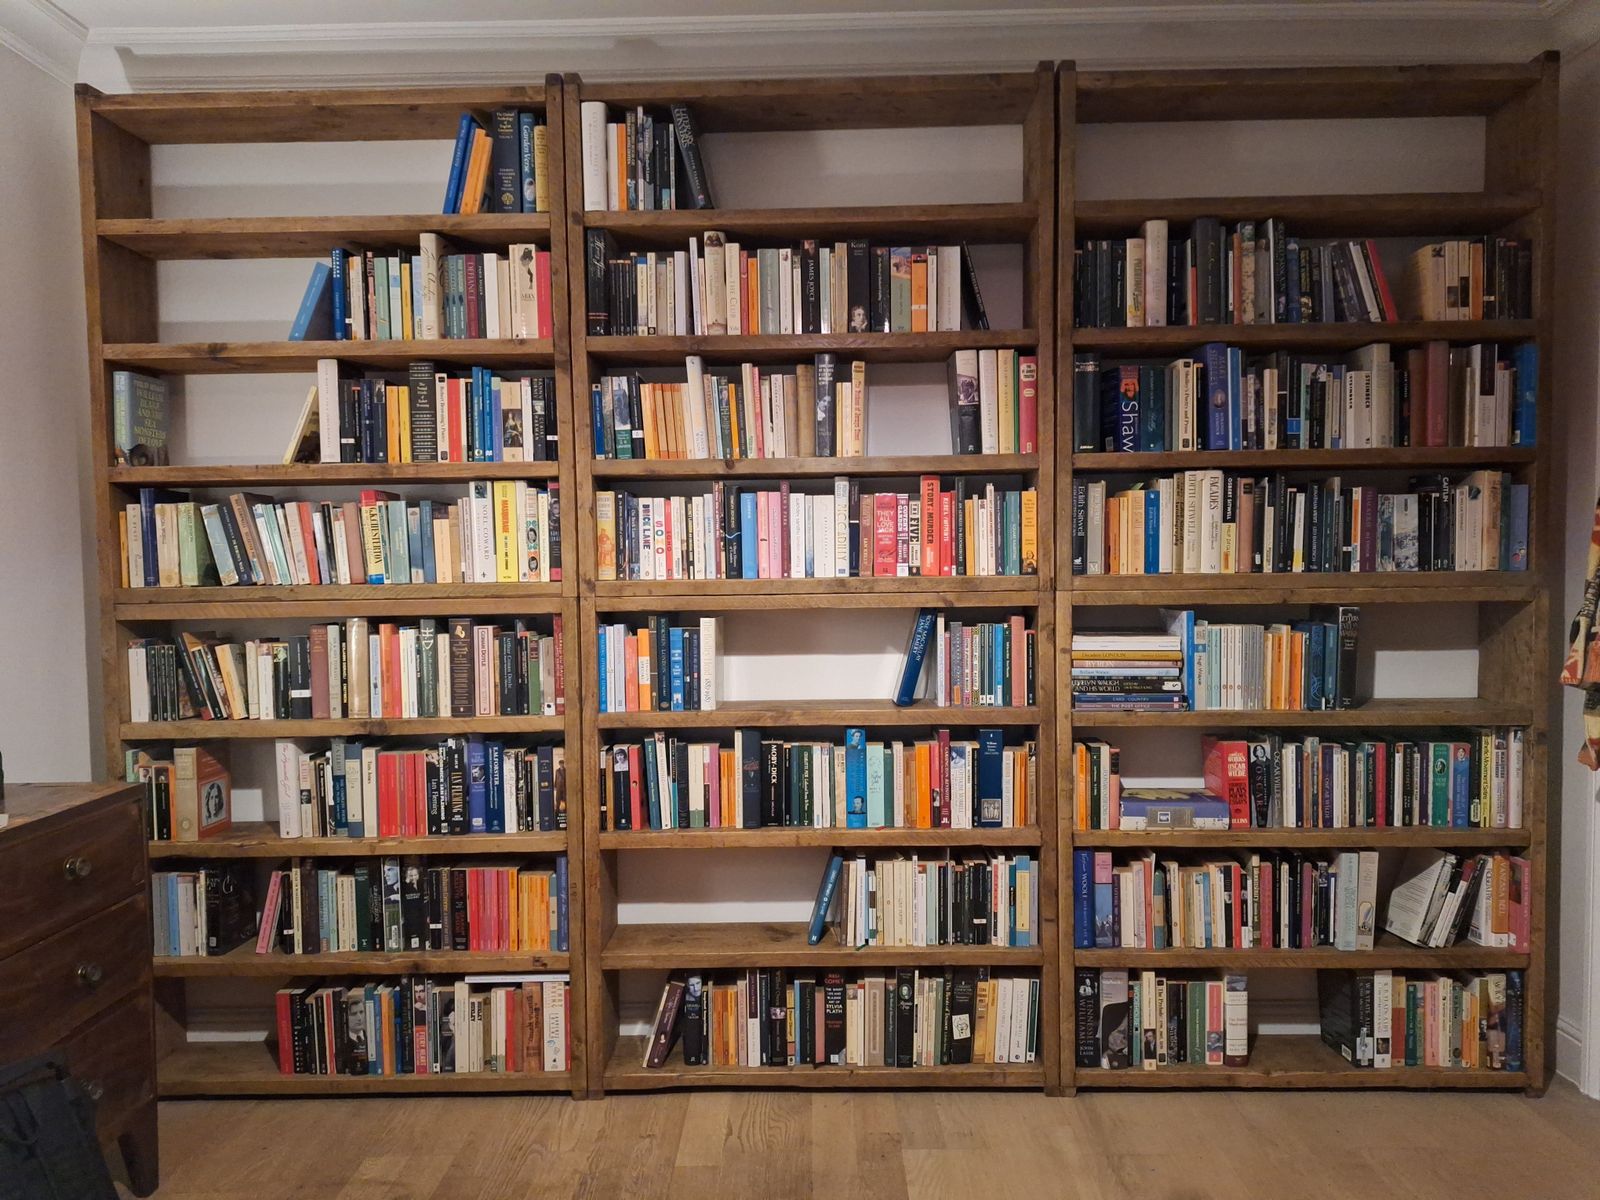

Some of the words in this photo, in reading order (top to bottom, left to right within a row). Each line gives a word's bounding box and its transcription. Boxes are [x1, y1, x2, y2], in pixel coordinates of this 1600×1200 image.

[1121, 401, 1139, 453] Shaw
[926, 482, 934, 507] STORY
[643, 528, 651, 550] LANE
[910, 517, 920, 542] FIVE
[926, 511, 934, 544] MURDER
[770, 744, 778, 784] MOBY-DICK
